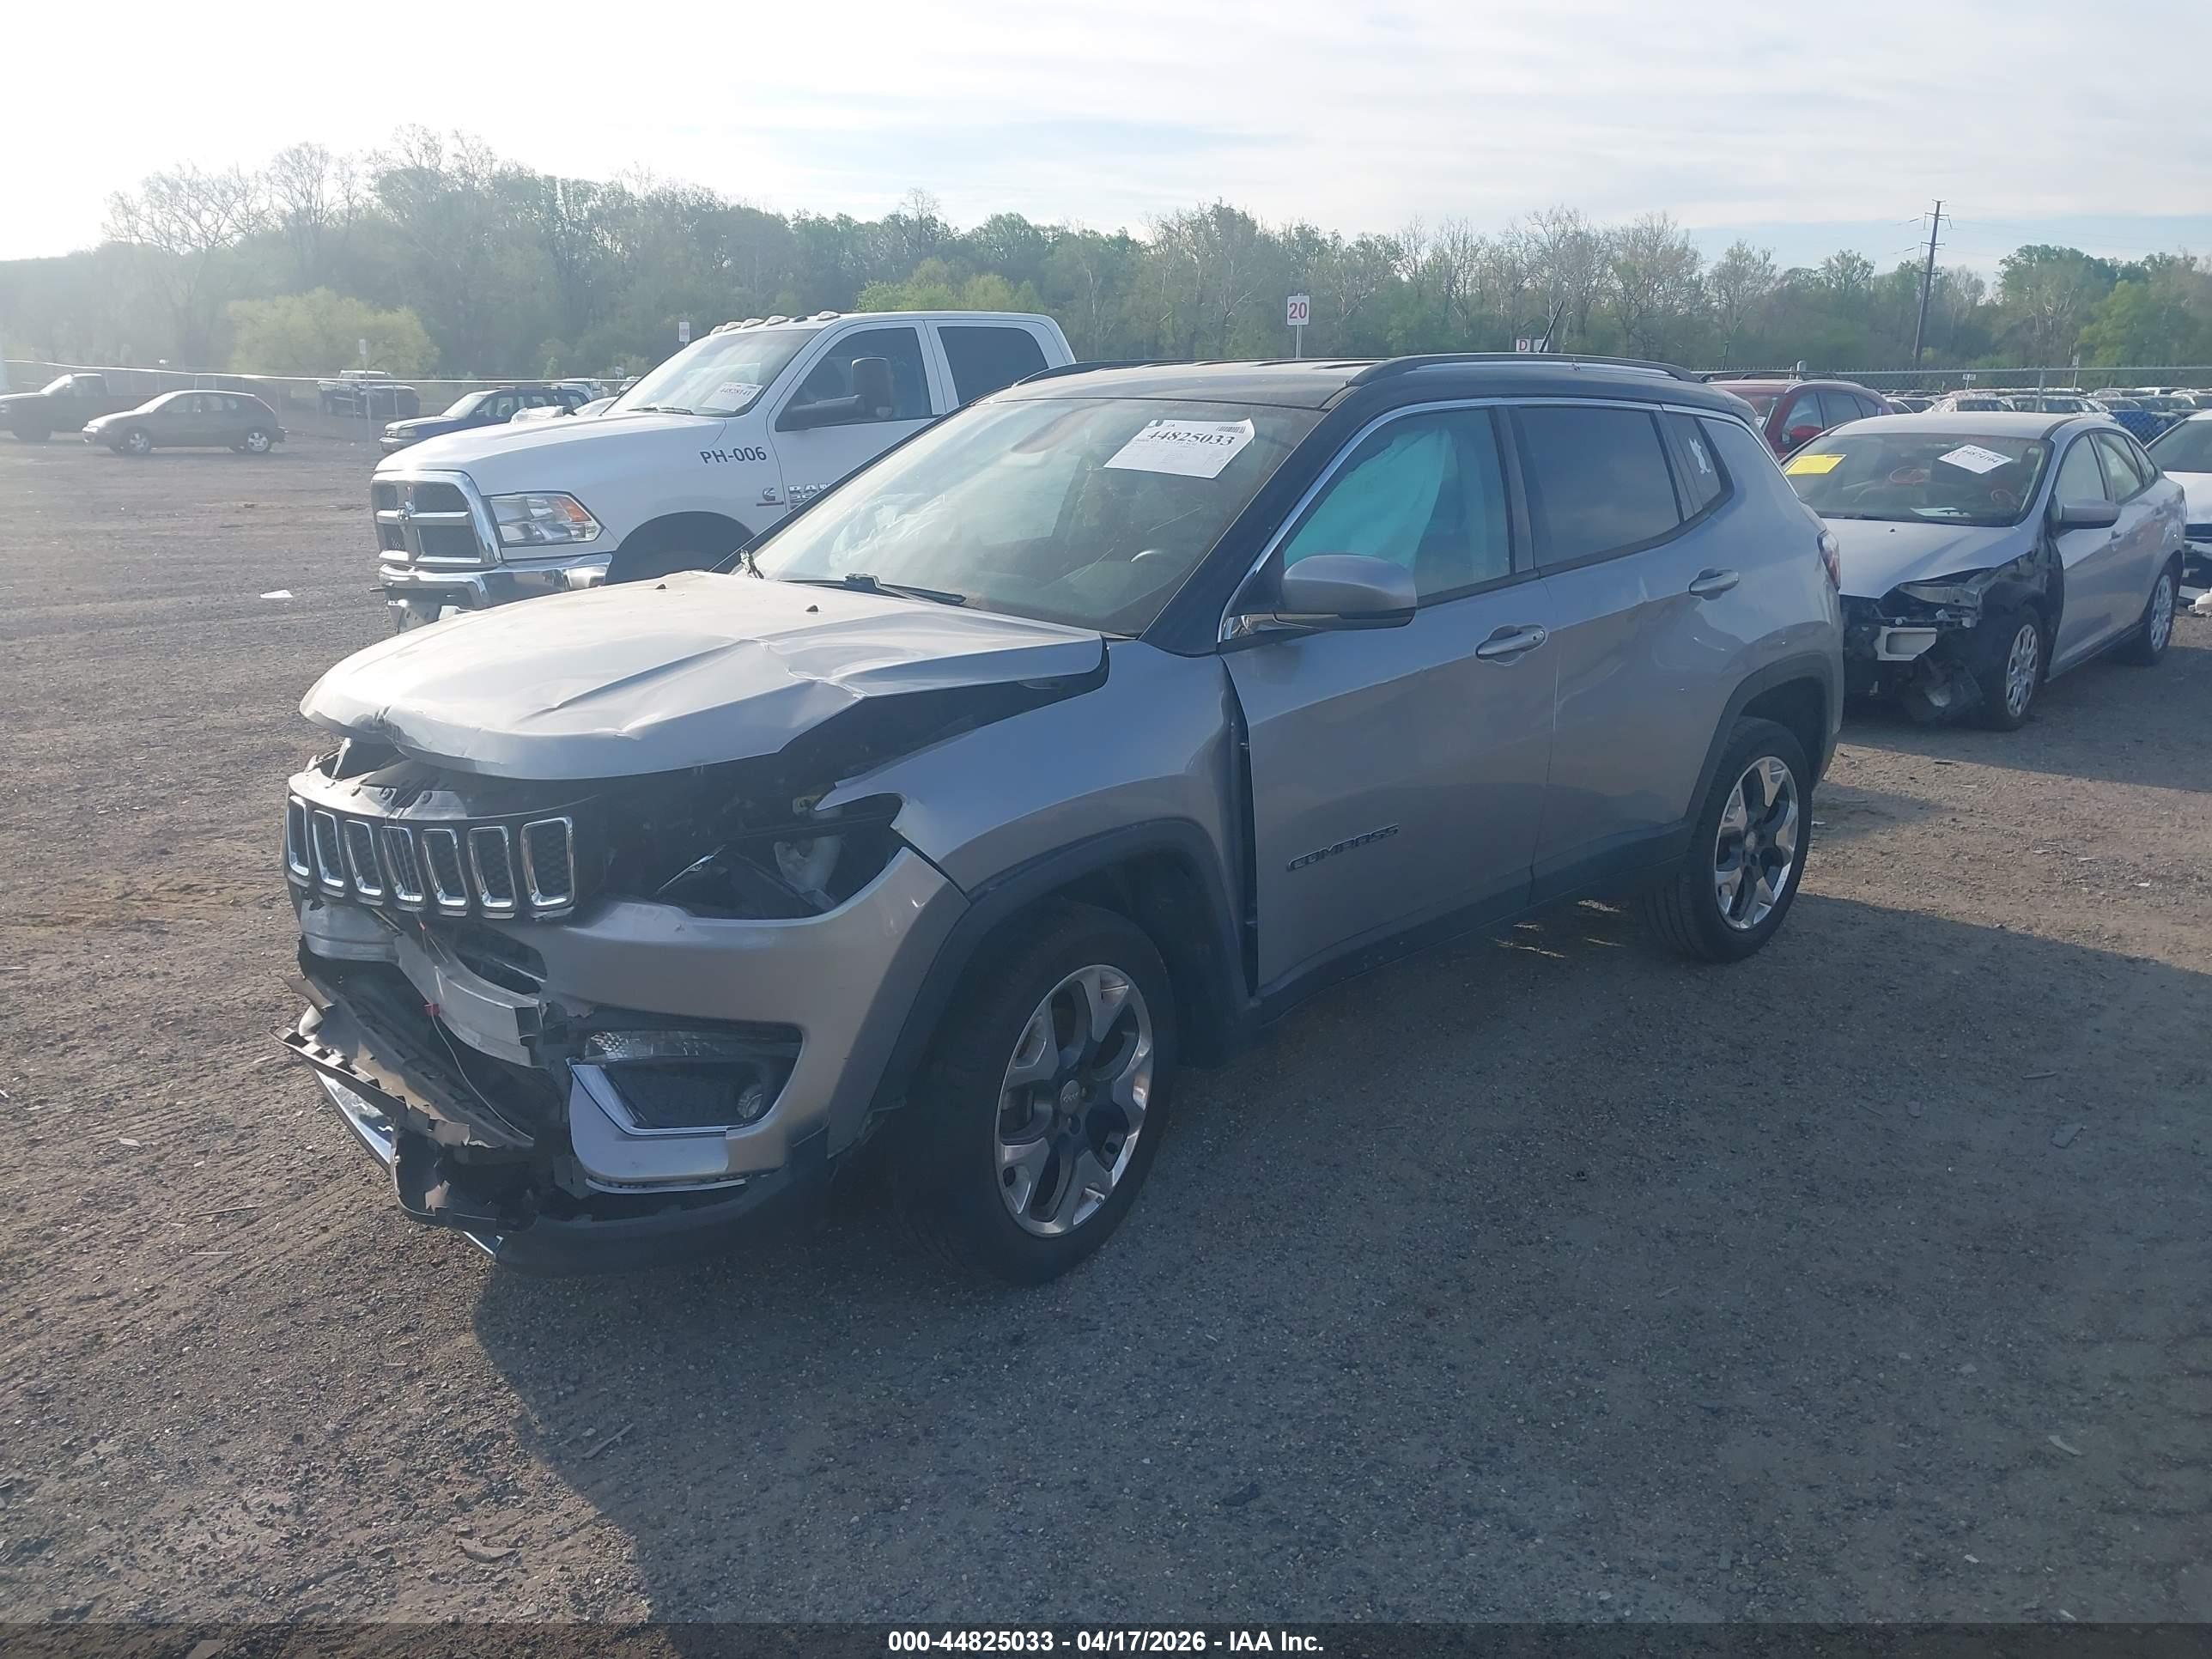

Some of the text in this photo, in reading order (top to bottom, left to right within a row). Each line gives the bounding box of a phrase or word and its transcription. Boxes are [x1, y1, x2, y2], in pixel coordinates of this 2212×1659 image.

[1289, 301, 1308, 319] 20
[1146, 430, 1236, 447] 44825033
[699, 446, 767, 465] PH-006
[1285, 823, 1399, 871] COMPASS
